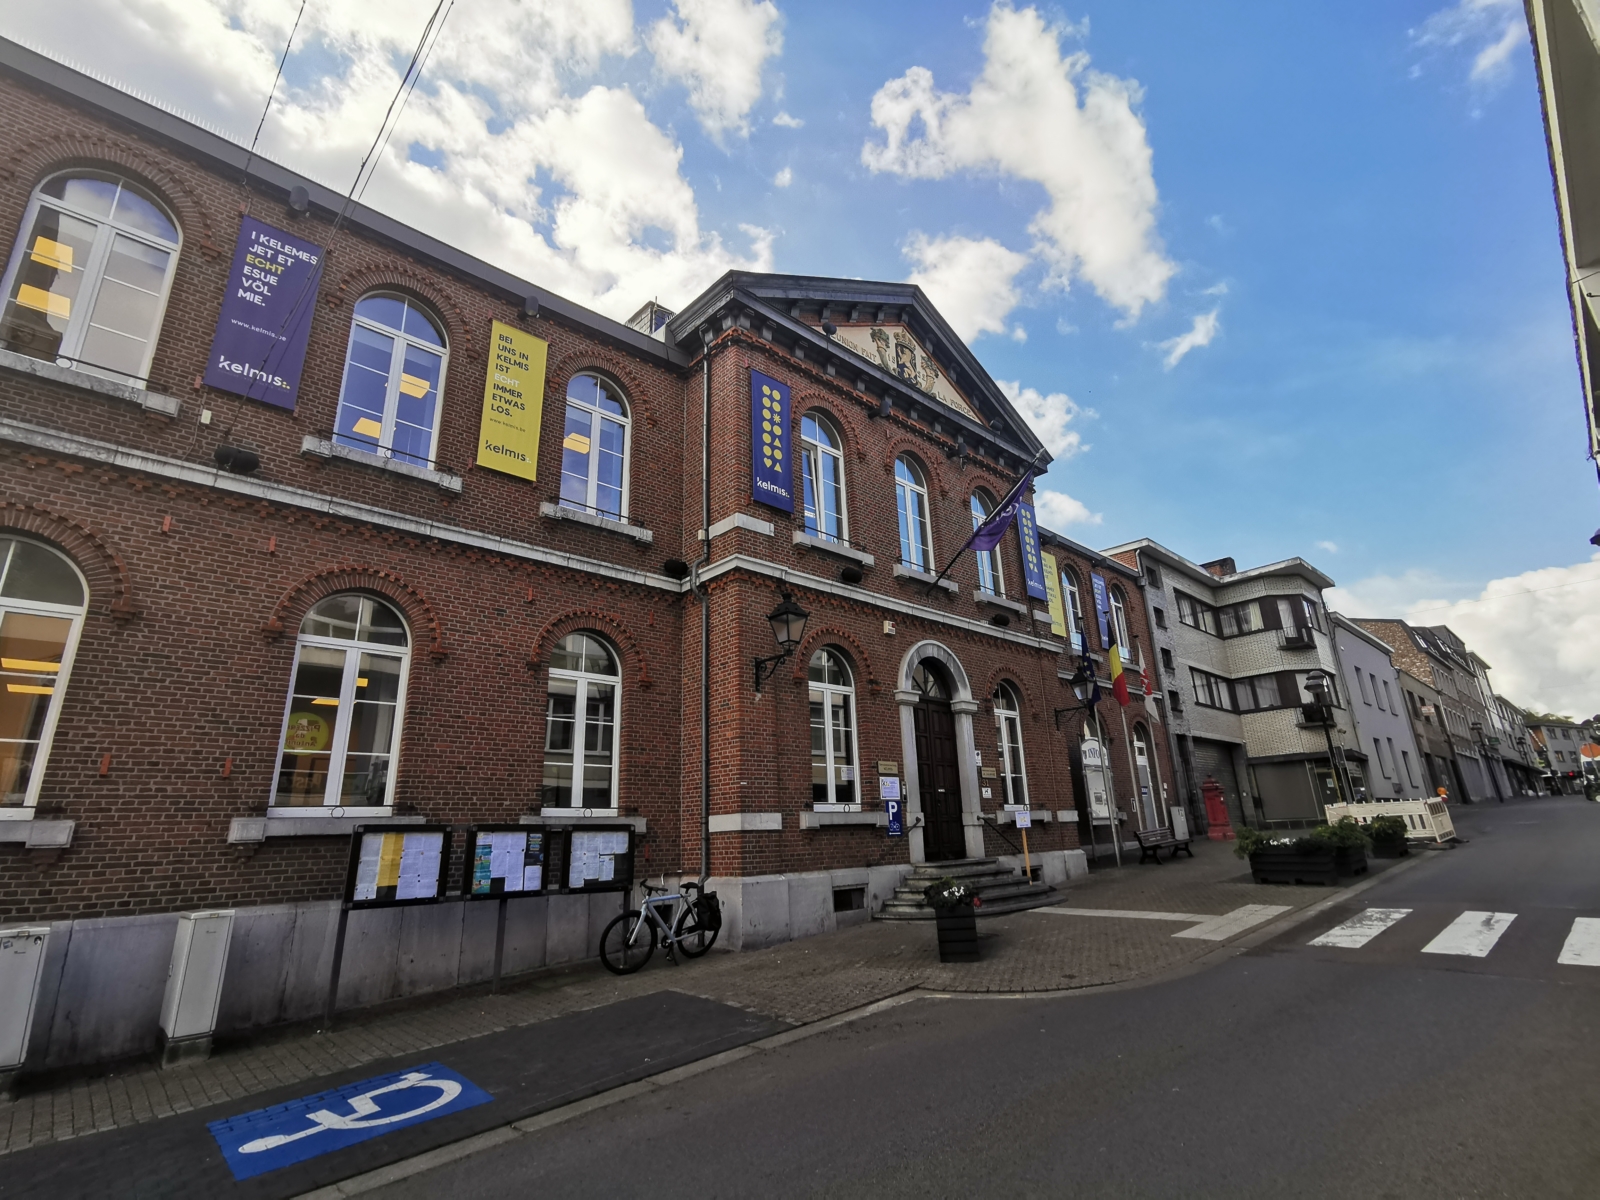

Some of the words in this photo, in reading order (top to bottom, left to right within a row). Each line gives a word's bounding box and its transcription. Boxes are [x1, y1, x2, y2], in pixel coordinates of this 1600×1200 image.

[249, 244, 275, 259] JET
[277, 254, 294, 267] ET
[251, 231, 256, 240] I
[259, 233, 318, 265] KELEMES
[246, 253, 285, 275] ECHT
[243, 266, 278, 286] ESUE
[241, 276, 271, 296] VÖL
[237, 289, 266, 306] MIE.
[499, 333, 513, 345] BEI
[498, 344, 516, 356] UNS
[519, 352, 529, 361] IN
[495, 363, 510, 374] IST
[496, 353, 529, 371] KELMIS
[494, 372, 520, 388] ECHT
[493, 382, 523, 399] IMMER
[491, 403, 513, 417] LOS.
[492, 392, 526, 411] ETWAS
[889, 801, 898, 821] P
